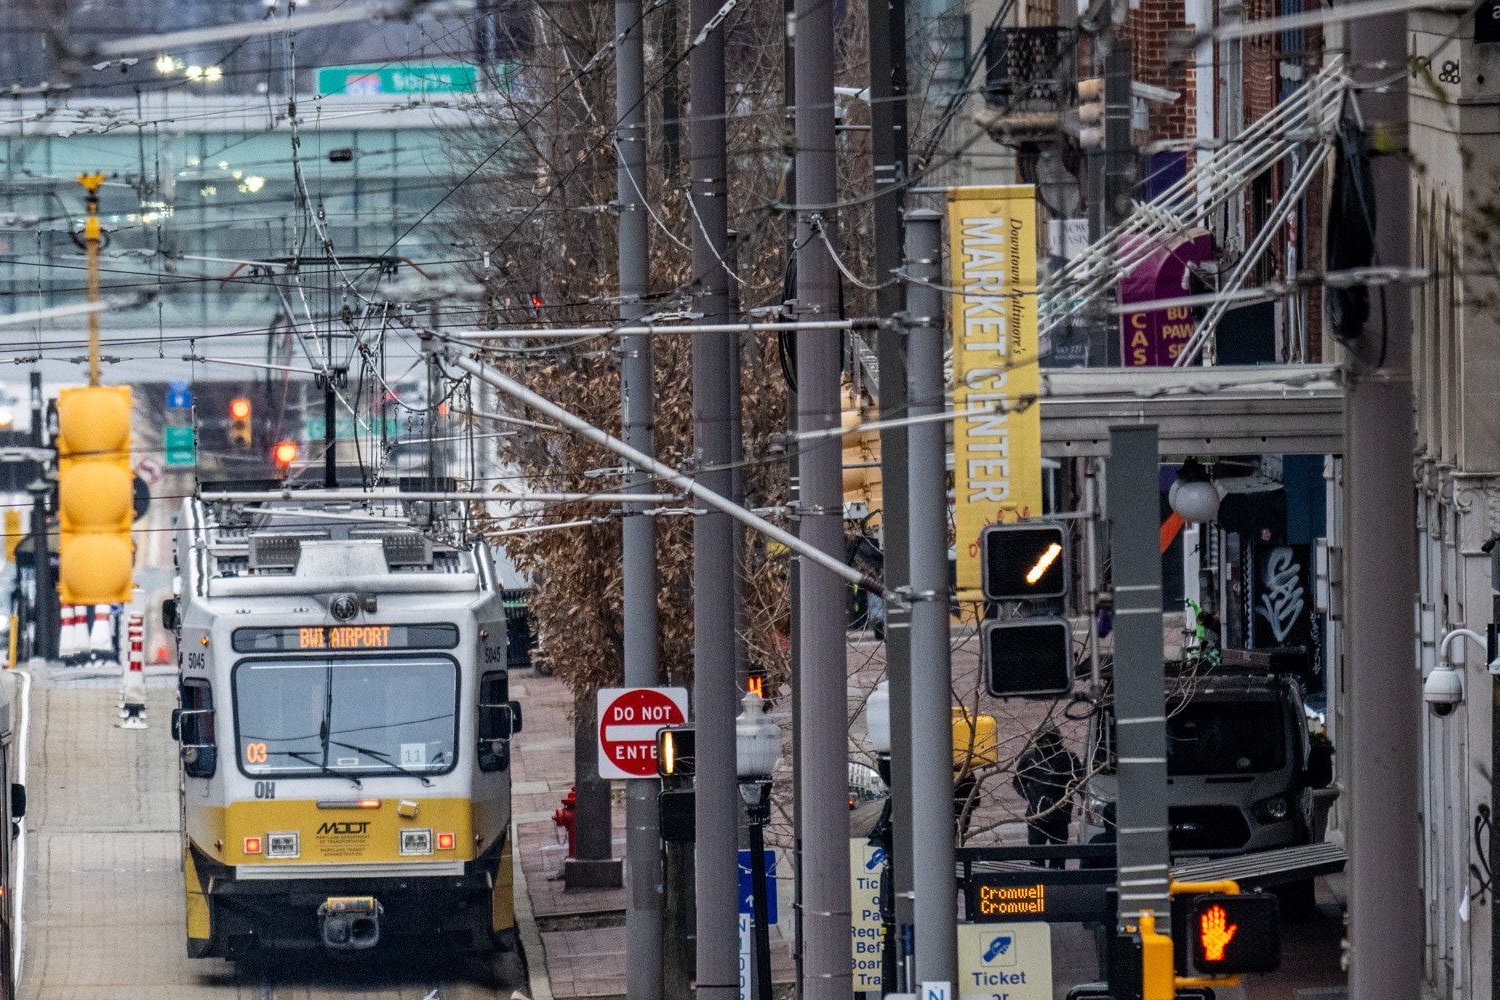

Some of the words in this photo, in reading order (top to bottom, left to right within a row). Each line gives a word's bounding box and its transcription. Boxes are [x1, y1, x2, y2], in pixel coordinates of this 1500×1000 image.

[1010, 218, 1023, 285] Downtown
[961, 216, 1007, 357] MARKET
[1167, 306, 1188, 321] BU
[1131, 312, 1149, 366] CAS
[1162, 324, 1193, 340] PAW
[966, 368, 1010, 504] CENTER
[299, 627, 325, 648] BWI
[331, 626, 390, 648] AIRPORT
[188, 652, 205, 669] 5045
[614, 706, 634, 721] DO
[642, 706, 671, 720] NOT
[246, 743, 267, 763] 03
[616, 745, 657, 759] ENTE
[254, 781, 275, 799] OH
[316, 821, 371, 834] MDOT
[857, 878, 879, 889] Tic
[981, 884, 1044, 900] Cromwell
[981, 899, 1044, 914] Cromwell
[862, 910, 881, 921] Pa
[856, 942, 881, 953] Bef
[858, 974, 882, 985] Tra
[972, 971, 1026, 986] Ticket
